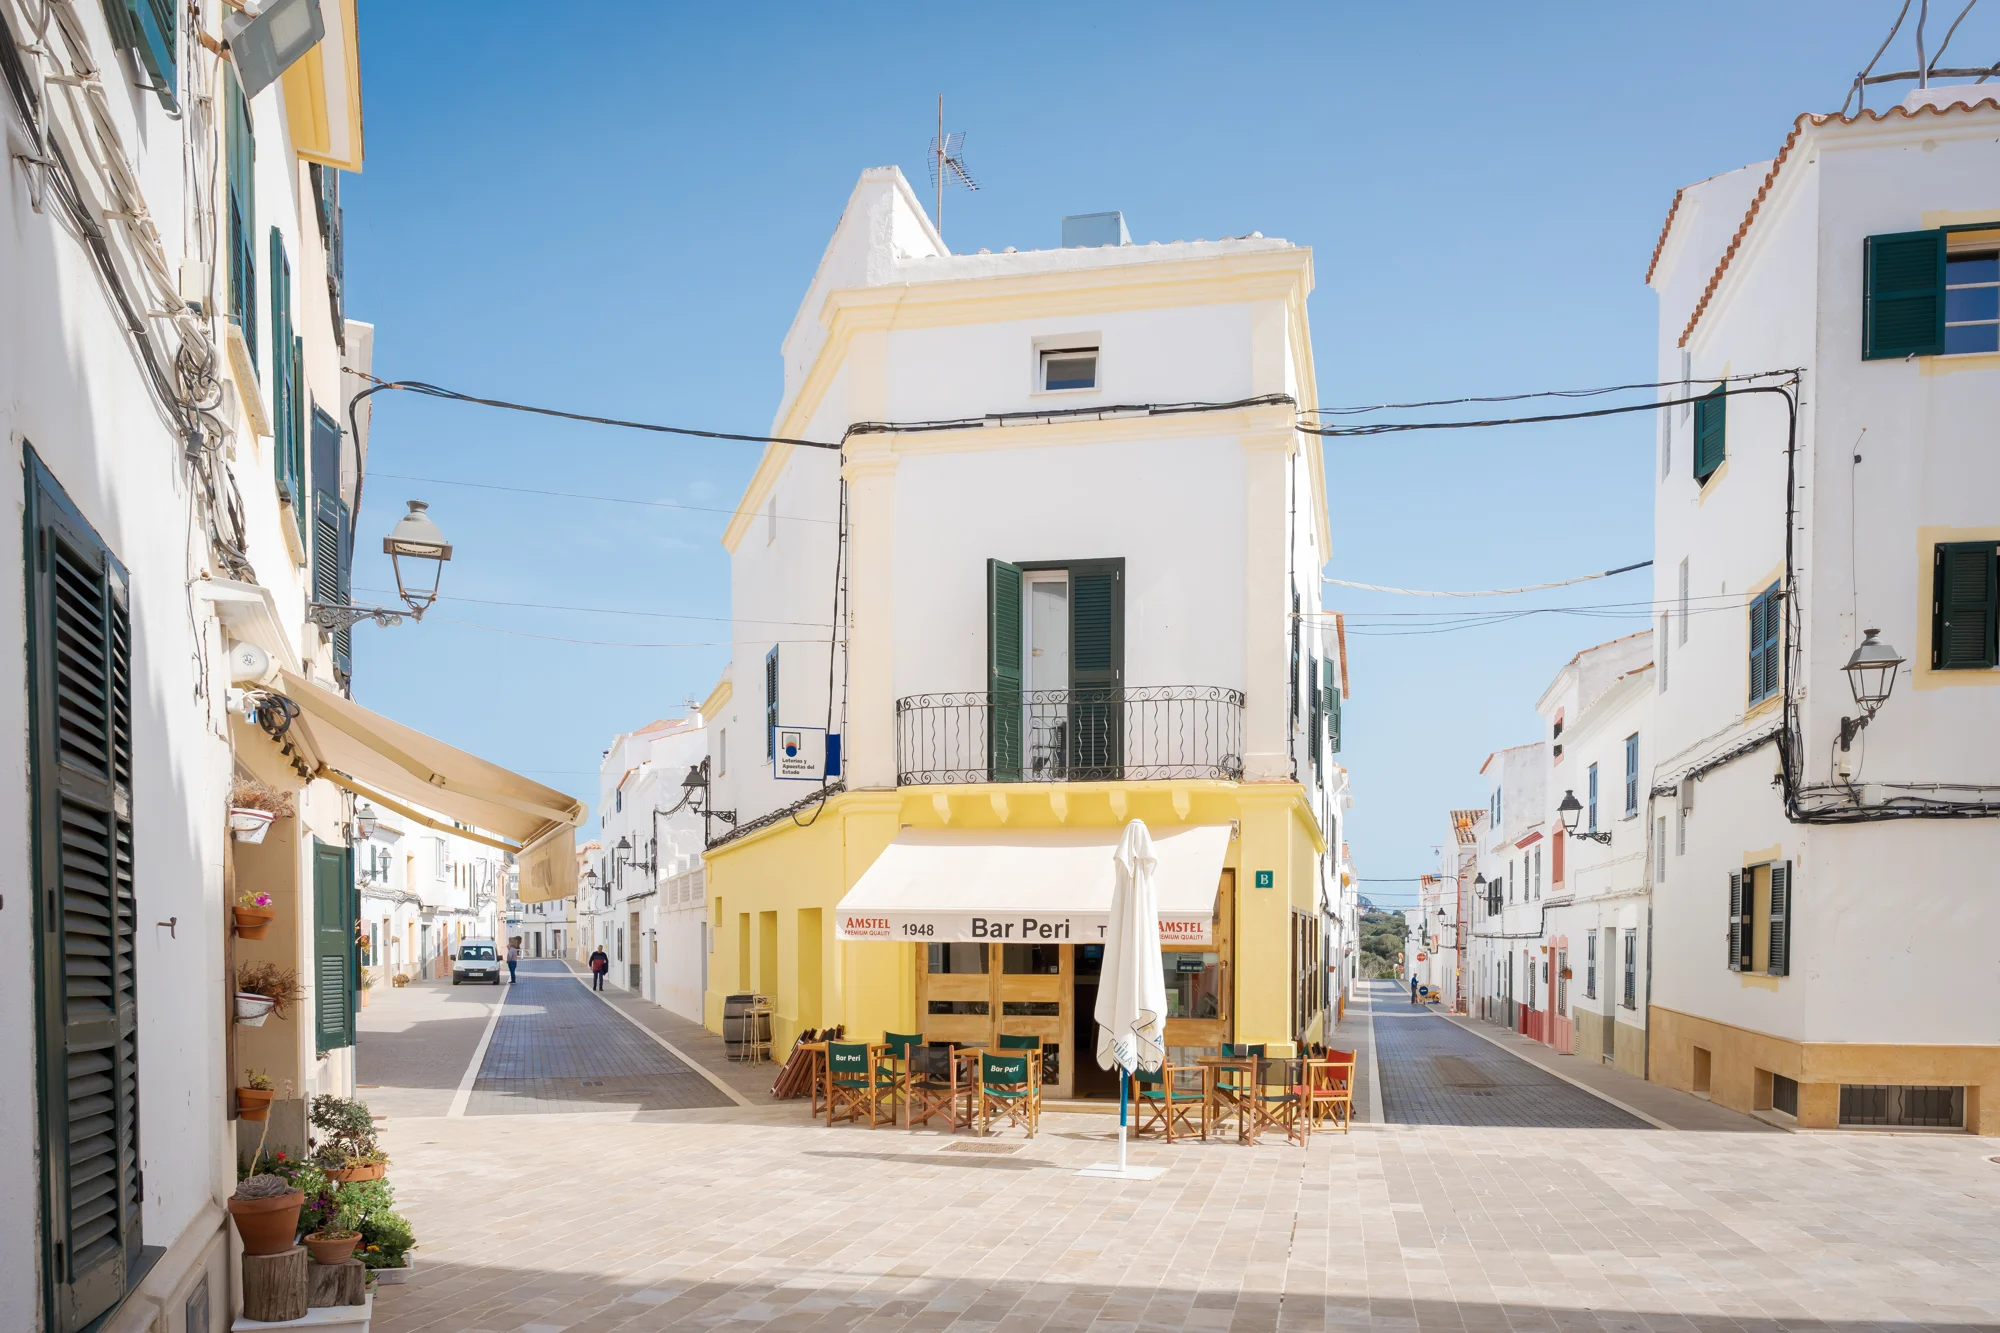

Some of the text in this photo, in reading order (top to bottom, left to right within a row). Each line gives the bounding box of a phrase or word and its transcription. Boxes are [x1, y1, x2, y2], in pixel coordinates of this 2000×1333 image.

[846, 917, 891, 929] AMSTEL
[972, 917, 1070, 938] Bar Peri
[902, 923, 934, 936] 1948
[1121, 1040, 1129, 1050] EL
[847, 1054, 861, 1062] Peri
[990, 1064, 1020, 1073] Bar Peri
